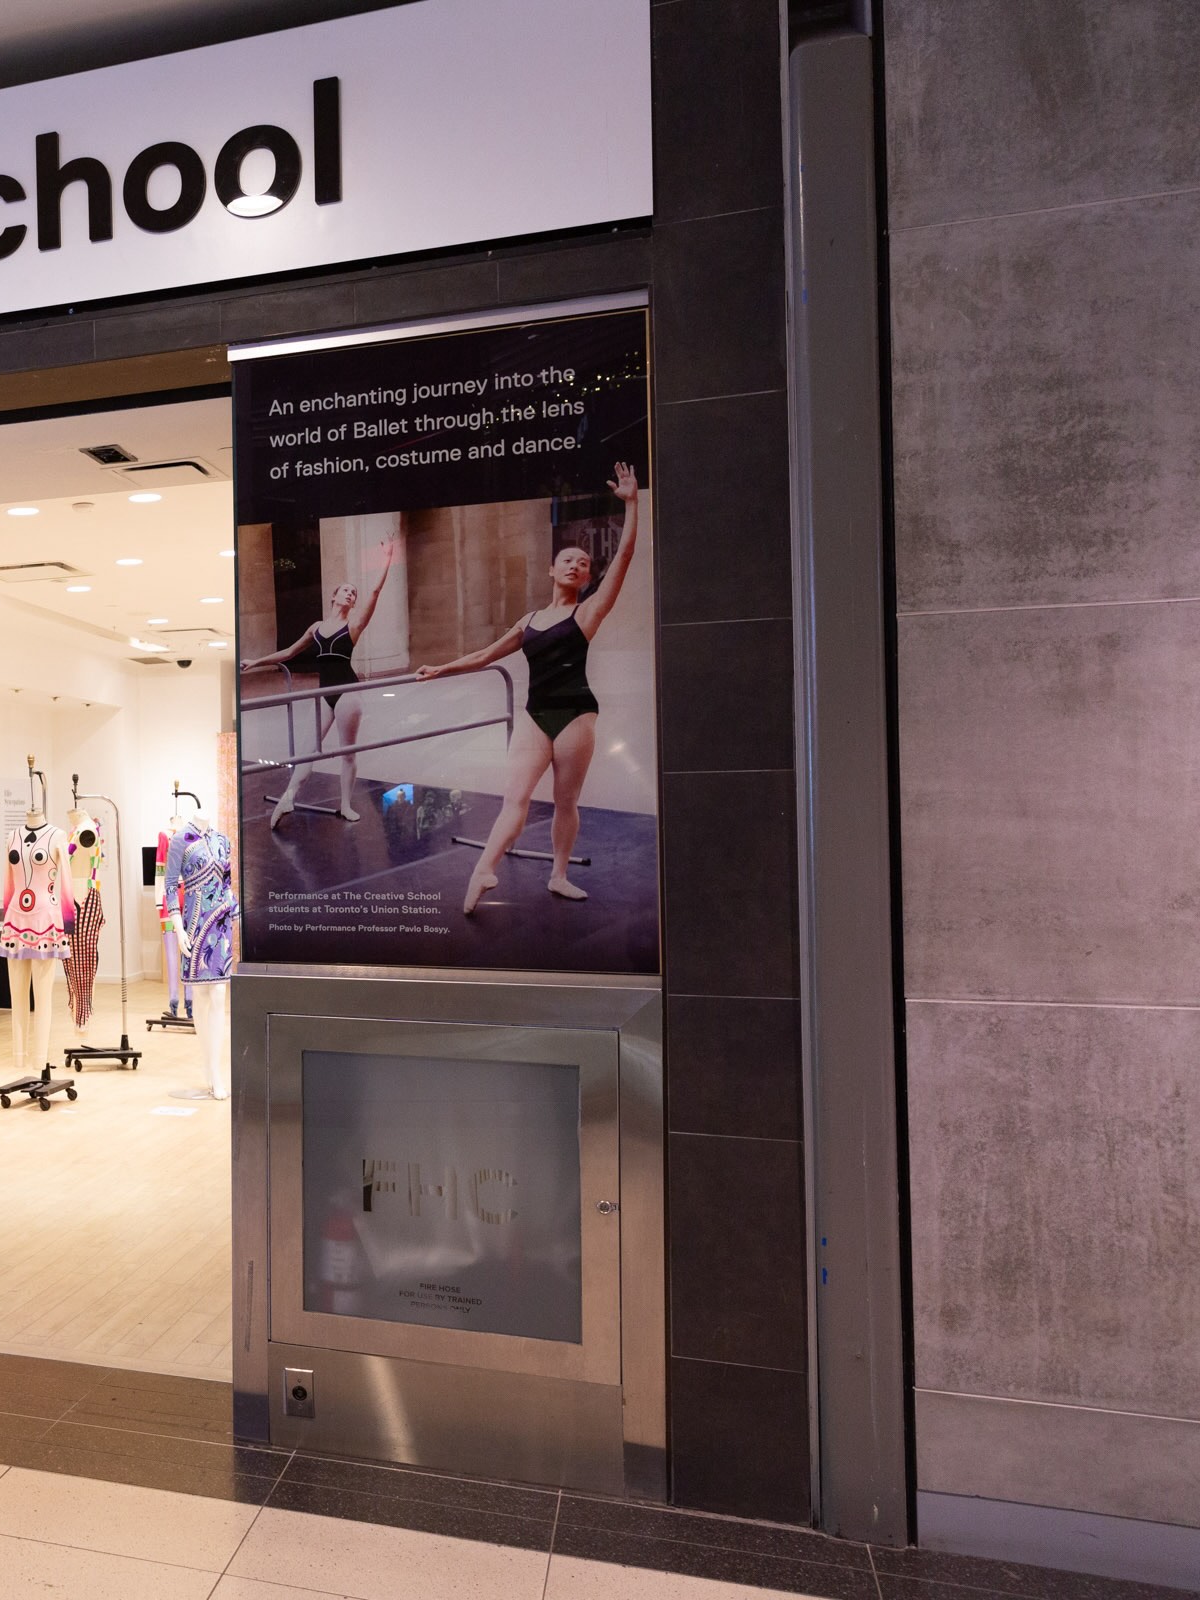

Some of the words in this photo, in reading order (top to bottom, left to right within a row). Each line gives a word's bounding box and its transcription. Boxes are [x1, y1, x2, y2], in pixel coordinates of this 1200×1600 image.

[269, 399, 294, 417] An
[299, 385, 407, 414] enchanting
[412, 376, 488, 404] journey
[494, 371, 534, 391] into
[541, 366, 576, 385] the
[270, 425, 321, 448] world
[327, 424, 347, 442] of
[353, 418, 408, 440] Ballet
[414, 409, 494, 433] through
[501, 405, 535, 424] the
[542, 400, 585, 419] lens
[269, 462, 289, 480] of
[295, 455, 370, 478] fashion,
[375, 447, 462, 469] costume
[468, 440, 506, 460] and
[511, 435, 582, 455] dance.
[268, 892, 328, 900] Performance
[343, 892, 361, 900] The
[364, 892, 404, 900] Creative
[407, 892, 441, 900] School
[268, 905, 310, 913] students
[402, 906, 441, 914] Station.
[294, 924, 303, 932] by
[424, 926, 450, 934] Bosyy.
[363, 1159, 518, 1225] FHC
[448, 1296, 482, 1305] TRAINED
